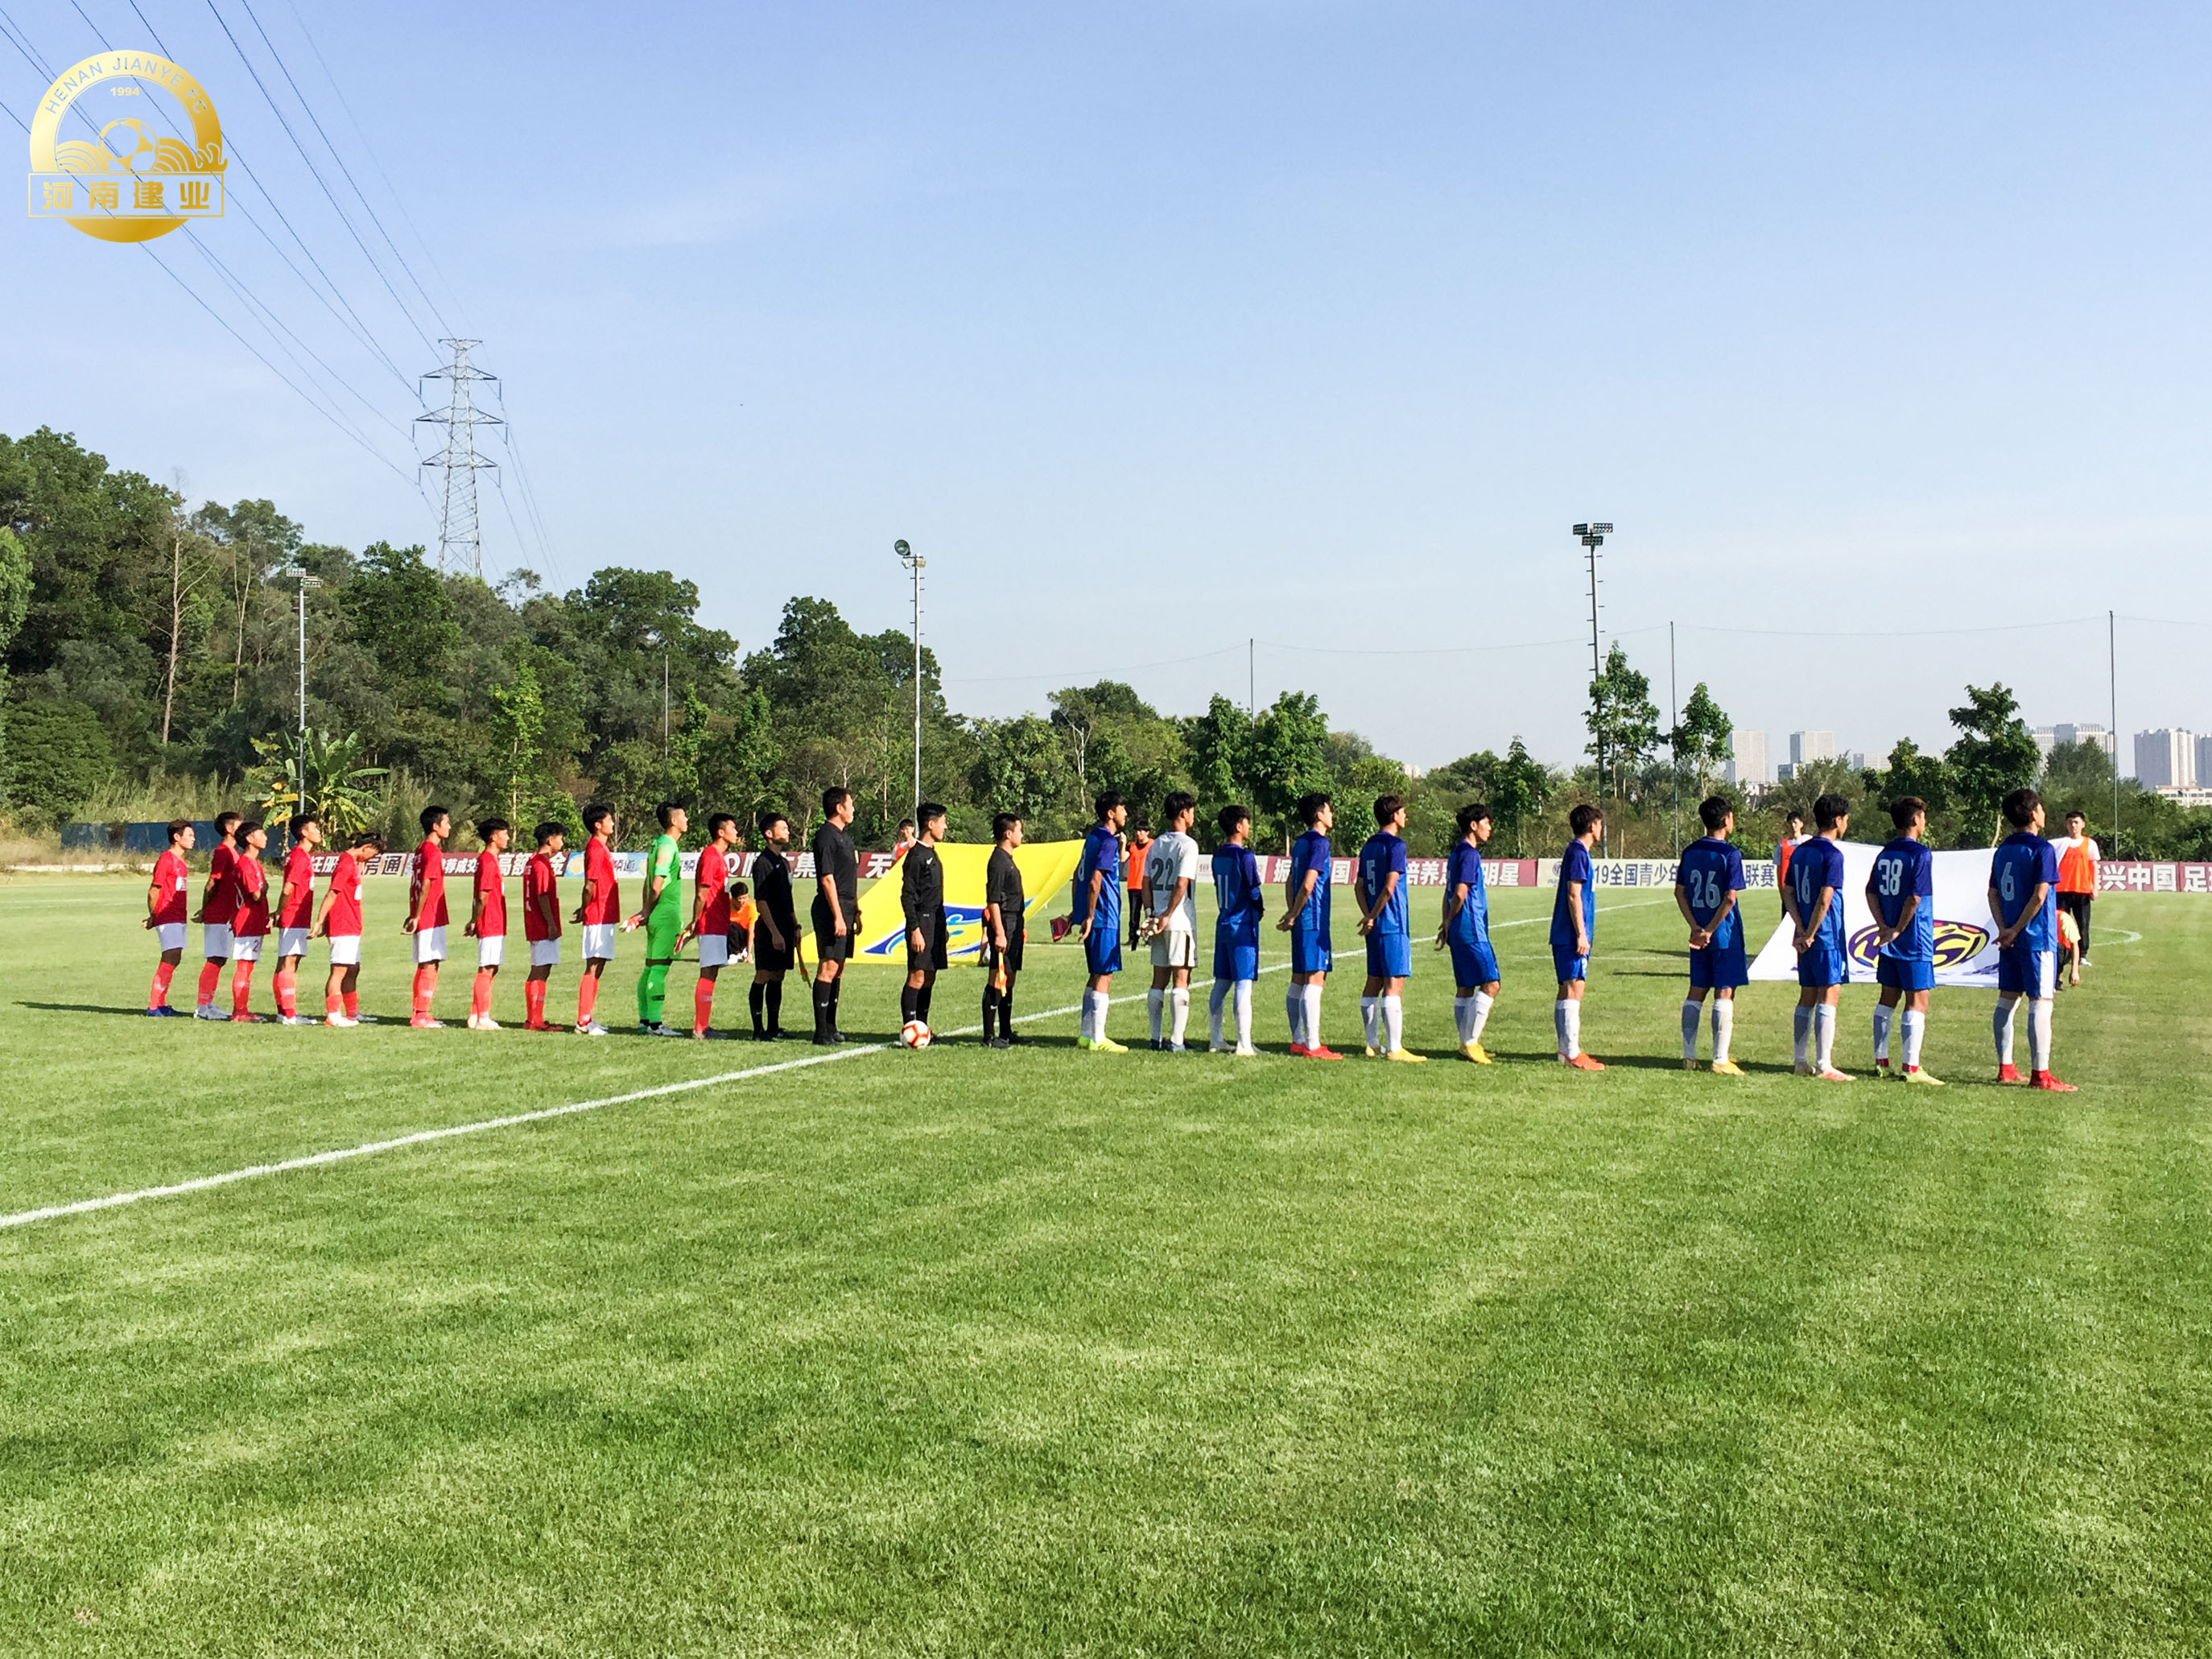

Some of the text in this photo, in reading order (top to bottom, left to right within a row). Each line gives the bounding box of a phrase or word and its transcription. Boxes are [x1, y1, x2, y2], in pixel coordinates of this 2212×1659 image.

[1151, 857, 1174, 891] 22
[1218, 874, 1229, 909] 11
[1367, 860, 1375, 896] 5
[1690, 869, 1721, 909] 26
[1794, 864, 1810, 904] 16
[1878, 859, 1903, 896] 38
[2000, 861, 2015, 901] 6
